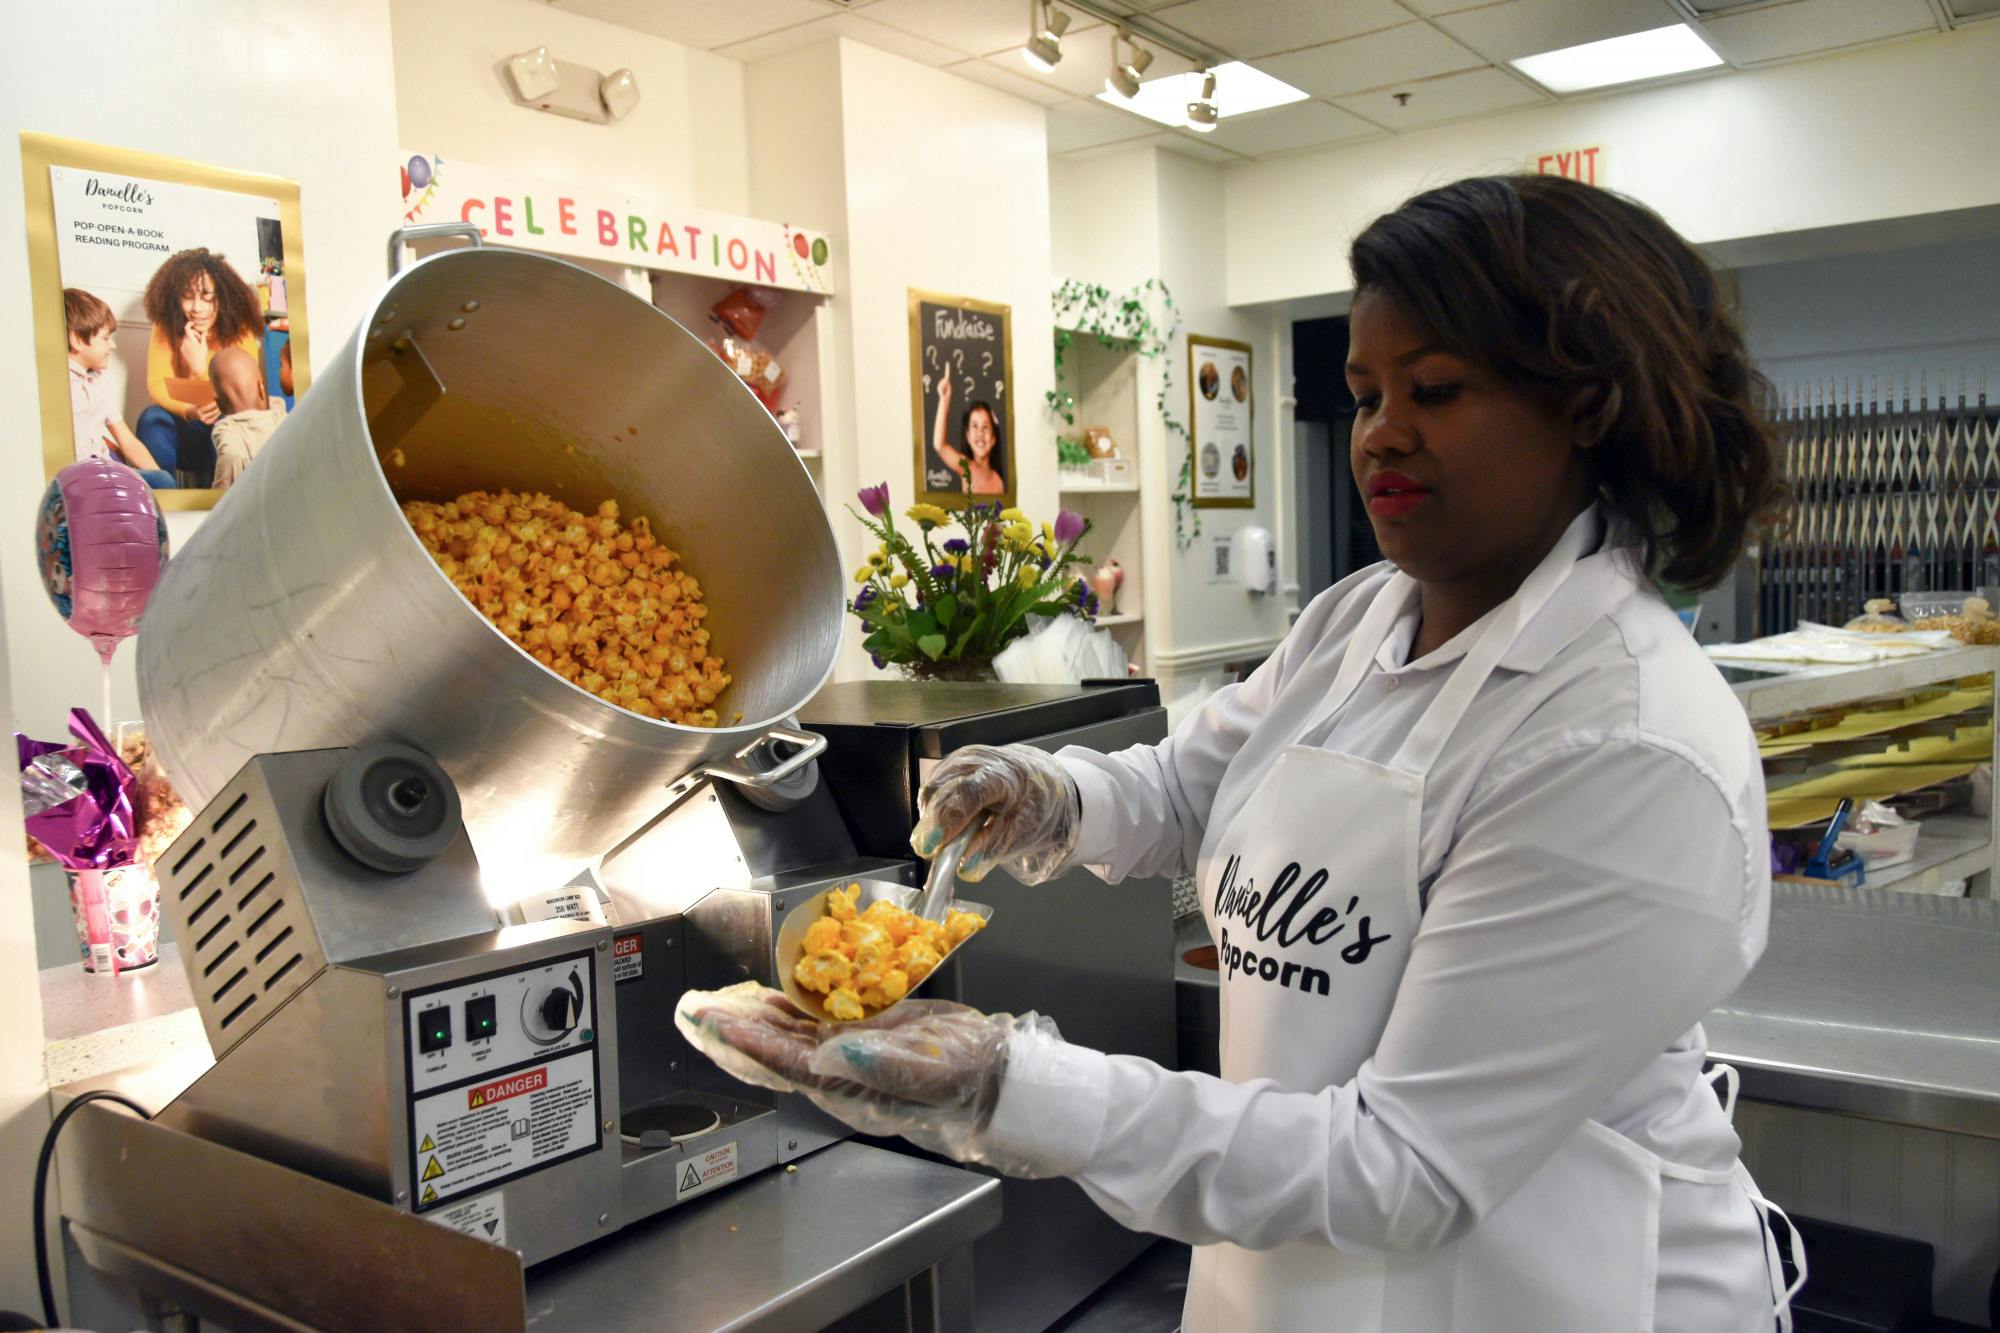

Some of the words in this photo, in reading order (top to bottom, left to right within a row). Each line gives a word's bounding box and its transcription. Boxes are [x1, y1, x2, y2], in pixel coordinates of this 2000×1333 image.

[85, 178, 155, 206] Danielle's
[102, 203, 144, 214] POPCORN
[74, 220, 165, 239] POP-OPEN-A-BOOK
[461, 196, 776, 283] CELEBRATION
[75, 234, 121, 248] READING
[122, 239, 170, 253] PROGRAM
[565, 902, 579, 911] WATT
[1214, 854, 1391, 964] Danielle's
[1221, 927, 1330, 996] Popcorn
[486, 1072, 543, 1102] DANGER
[705, 1147, 731, 1162] CAUTION
